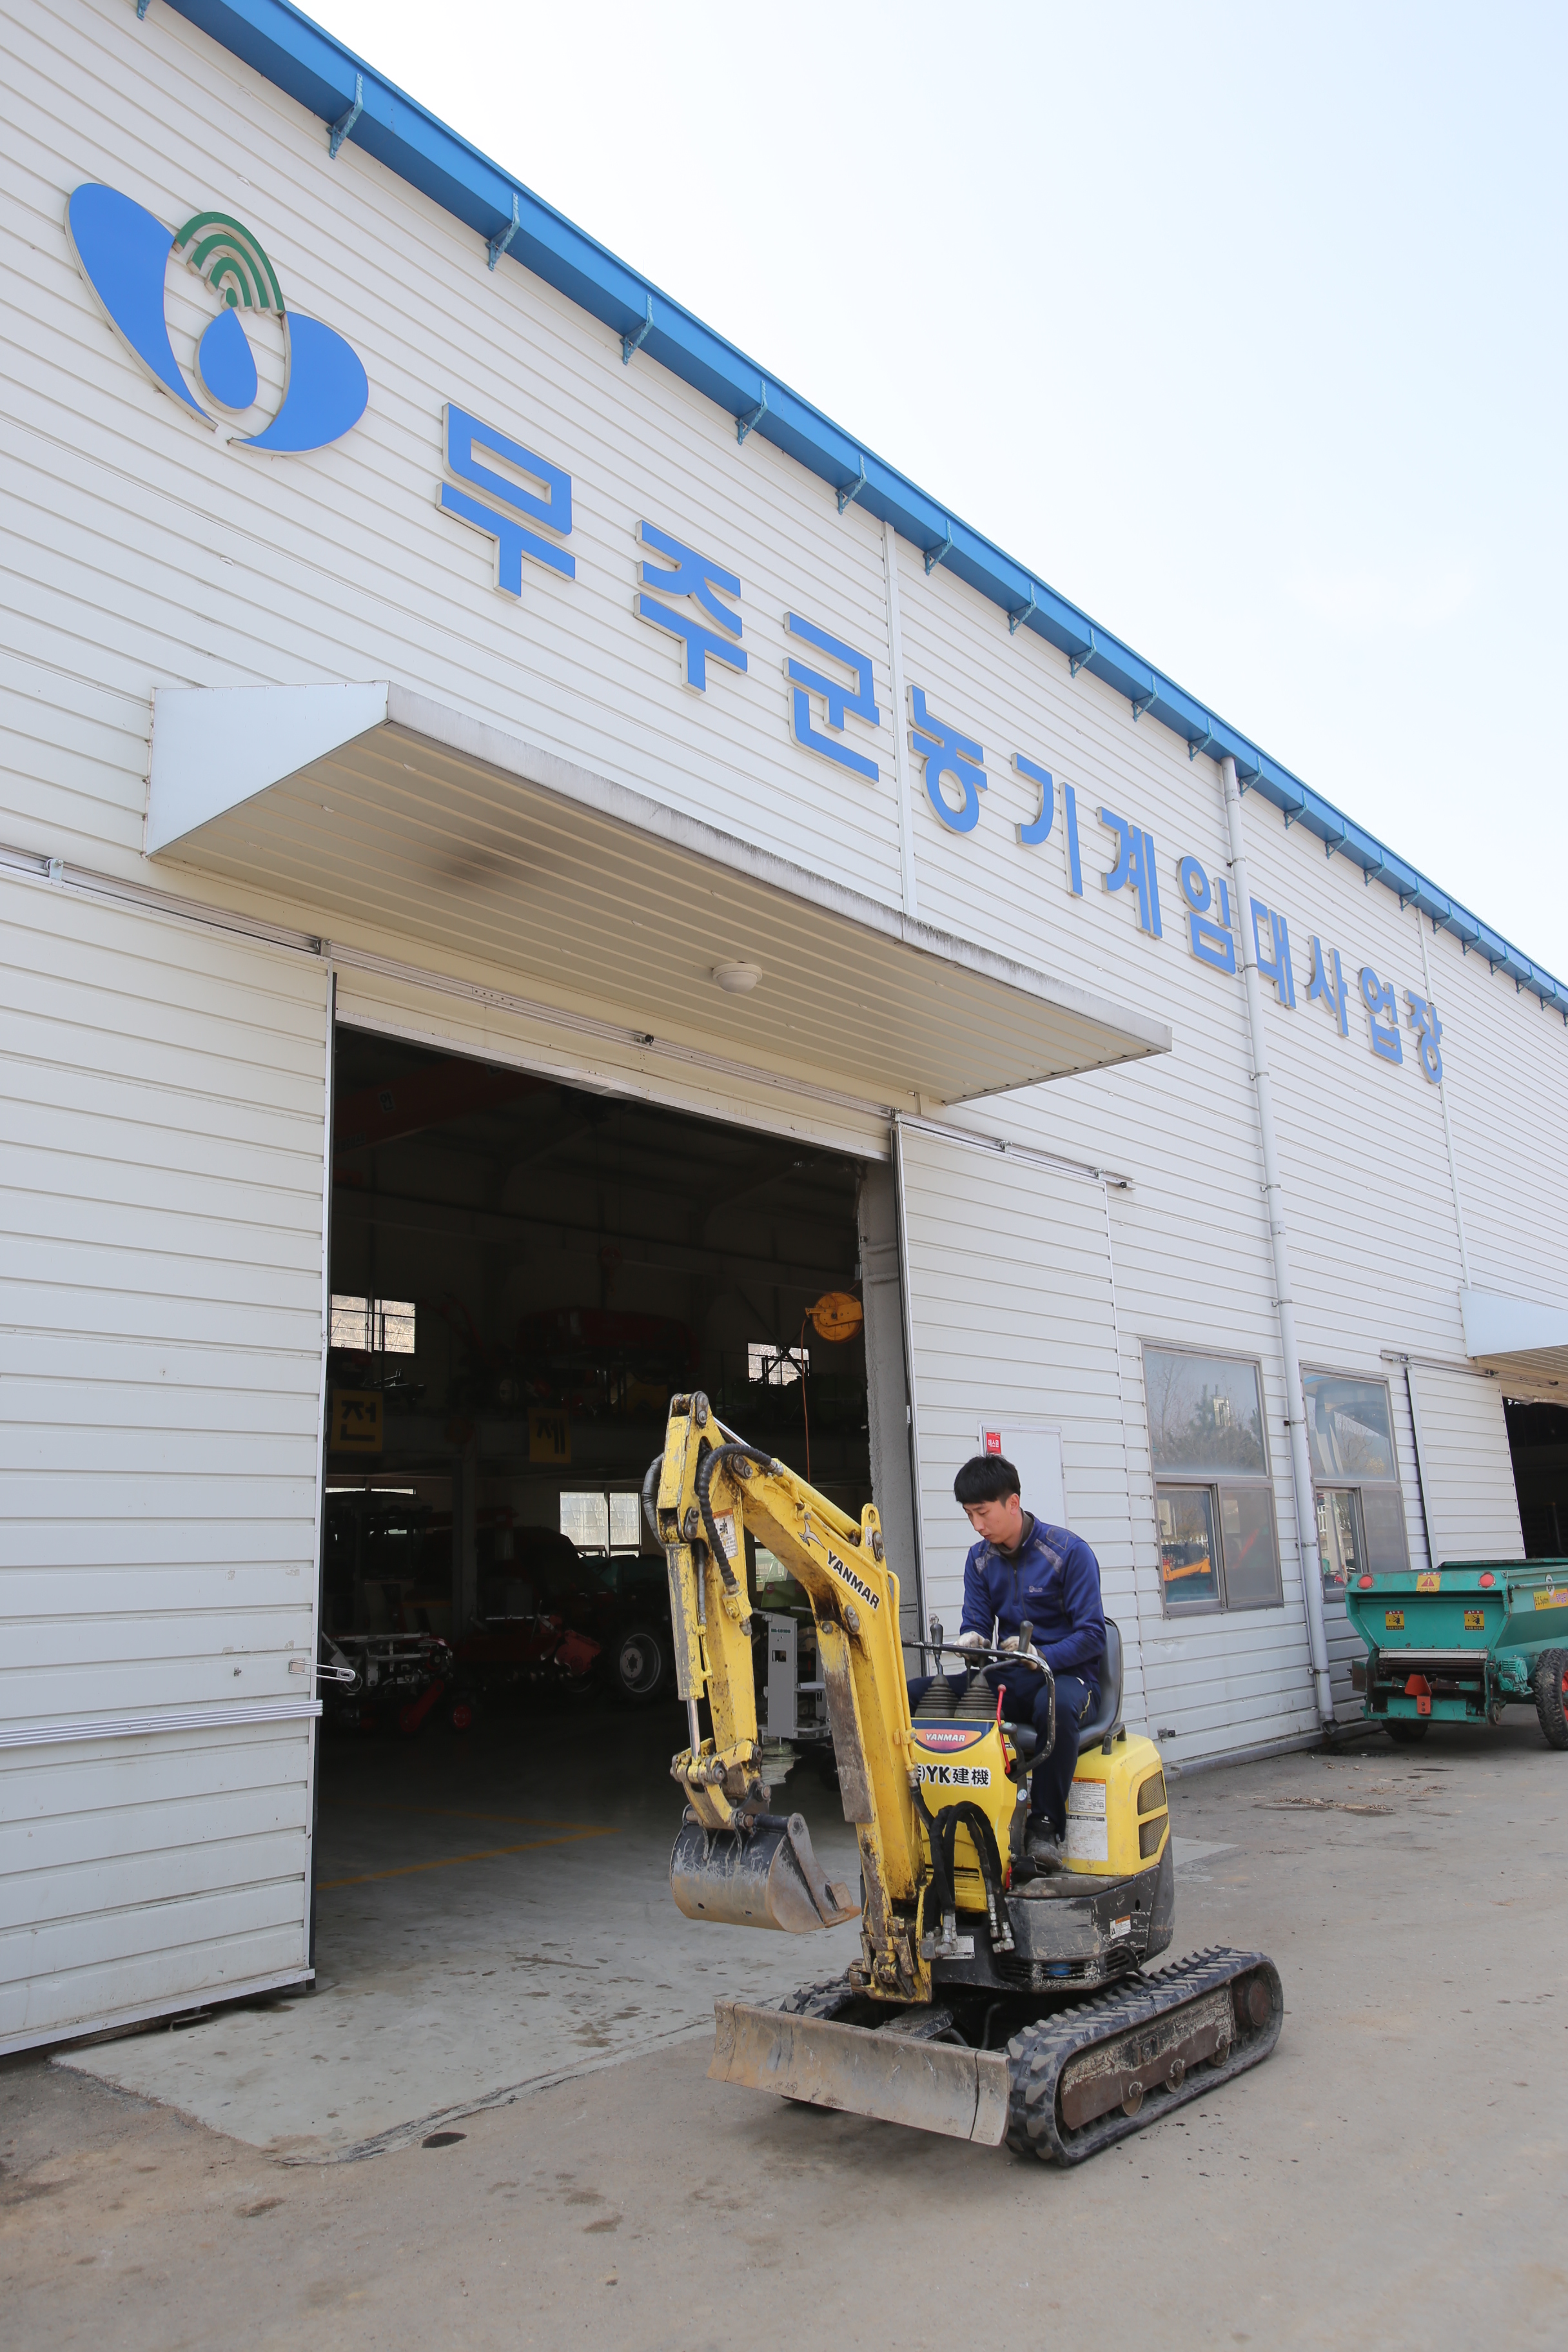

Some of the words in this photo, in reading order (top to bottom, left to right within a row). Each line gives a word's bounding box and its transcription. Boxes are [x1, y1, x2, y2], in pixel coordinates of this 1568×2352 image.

[340, 1400, 377, 1442] 전
[535, 1417, 566, 1455] 제
[987, 1438, 999, 1448] 에스원
[828, 1549, 879, 1609] YANMAR
[926, 1733, 966, 1741] YANMAR
